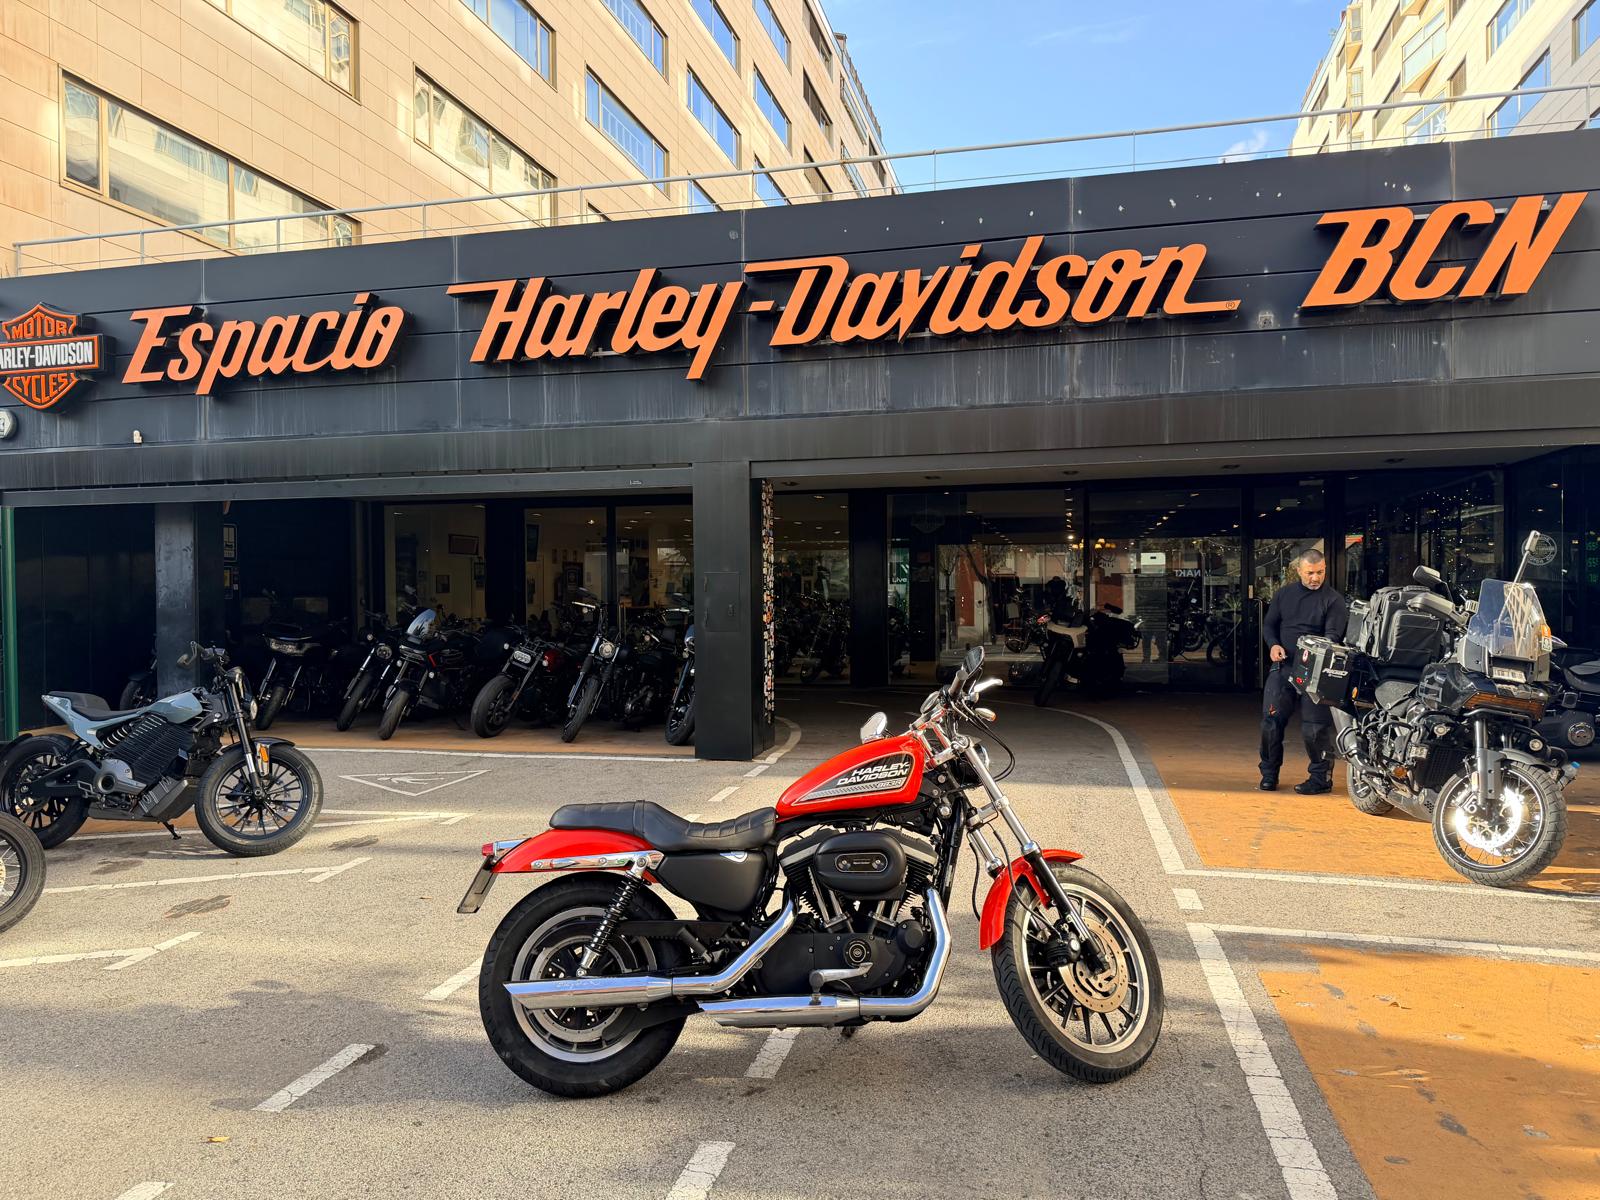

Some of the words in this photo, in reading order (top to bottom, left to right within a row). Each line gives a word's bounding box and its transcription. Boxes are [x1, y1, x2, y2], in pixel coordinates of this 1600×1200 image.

[121, 293, 404, 395] Espacio
[1302, 192, 1588, 307] BCN
[12, 312, 68, 339] MOTOR
[13, 373, 69, 404] CYCLES
[836, 768, 909, 786] DAVIDSON
